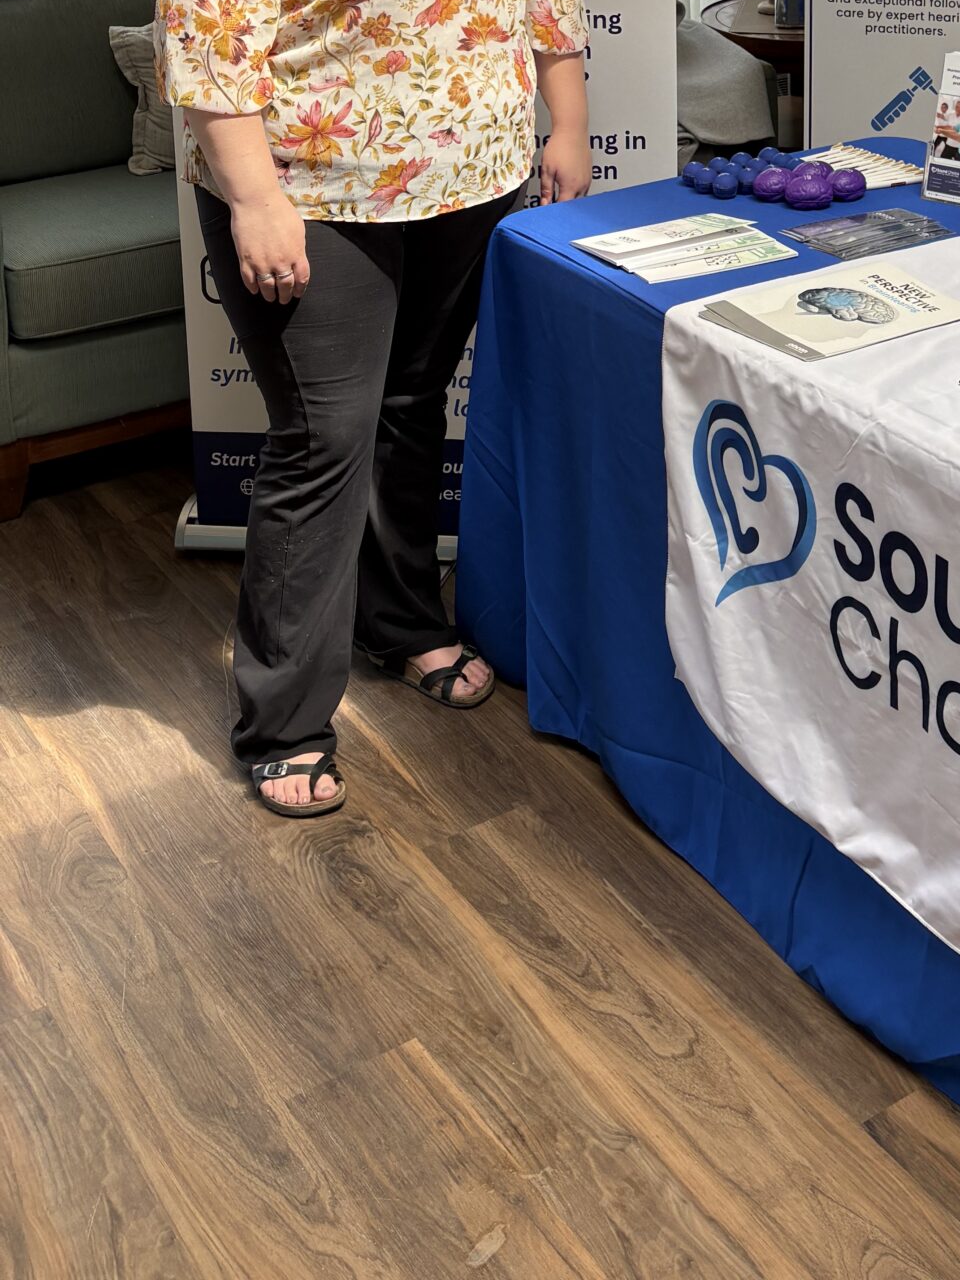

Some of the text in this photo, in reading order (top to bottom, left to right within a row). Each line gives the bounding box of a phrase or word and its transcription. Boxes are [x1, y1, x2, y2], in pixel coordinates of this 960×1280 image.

[836, 9, 864, 18] care
[868, 9, 883, 22] by
[886, 11, 924, 23] expert
[865, 24, 946, 36] practitioners.
[625, 130, 646, 150] in
[867, 274, 941, 313] PERSPECTIVE
[900, 283, 931, 299] NEW
[210, 452, 256, 467] Start
